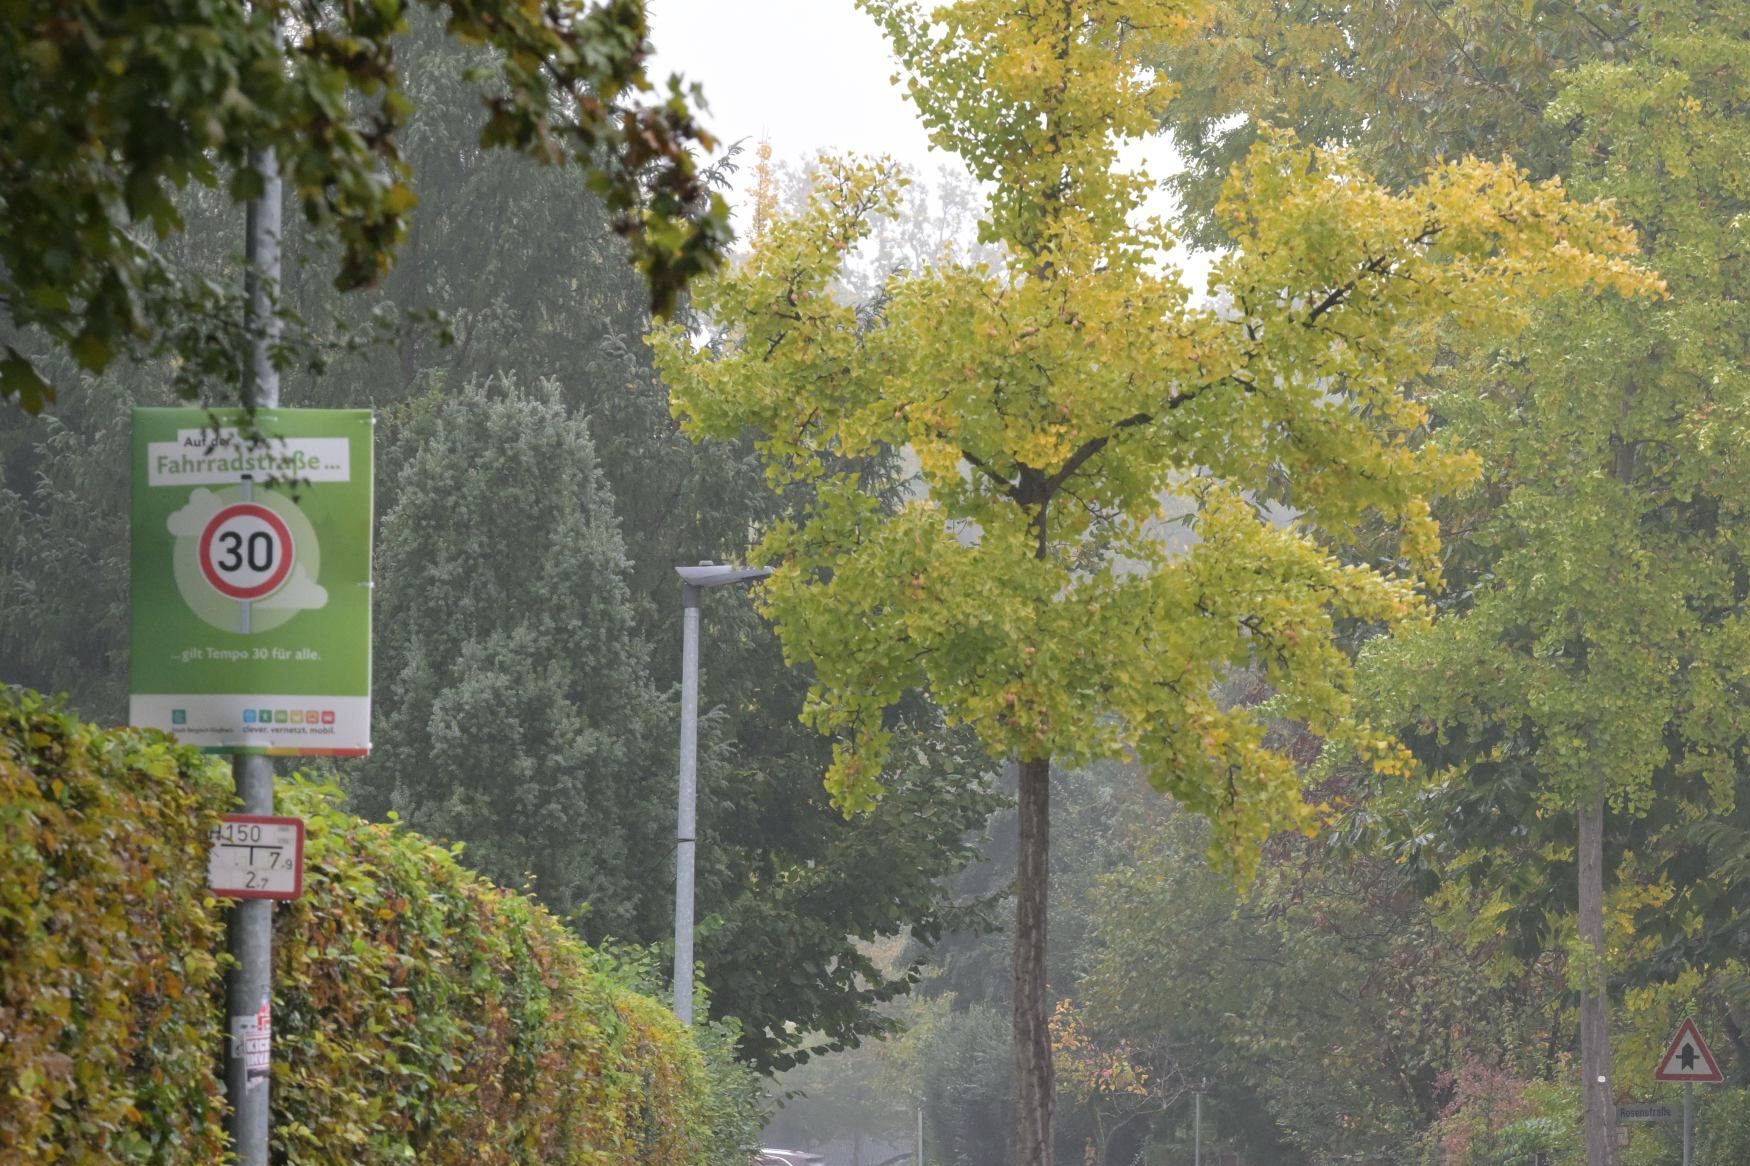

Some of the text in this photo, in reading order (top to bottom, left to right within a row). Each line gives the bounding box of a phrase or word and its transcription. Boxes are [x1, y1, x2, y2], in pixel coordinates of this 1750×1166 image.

[157, 450, 320, 475] Fahrradstraße
[217, 530, 274, 573] 30
[206, 648, 248, 661] Tempo
[252, 648, 269, 659] 30
[272, 647, 291, 660] für
[295, 648, 321, 660] alle.
